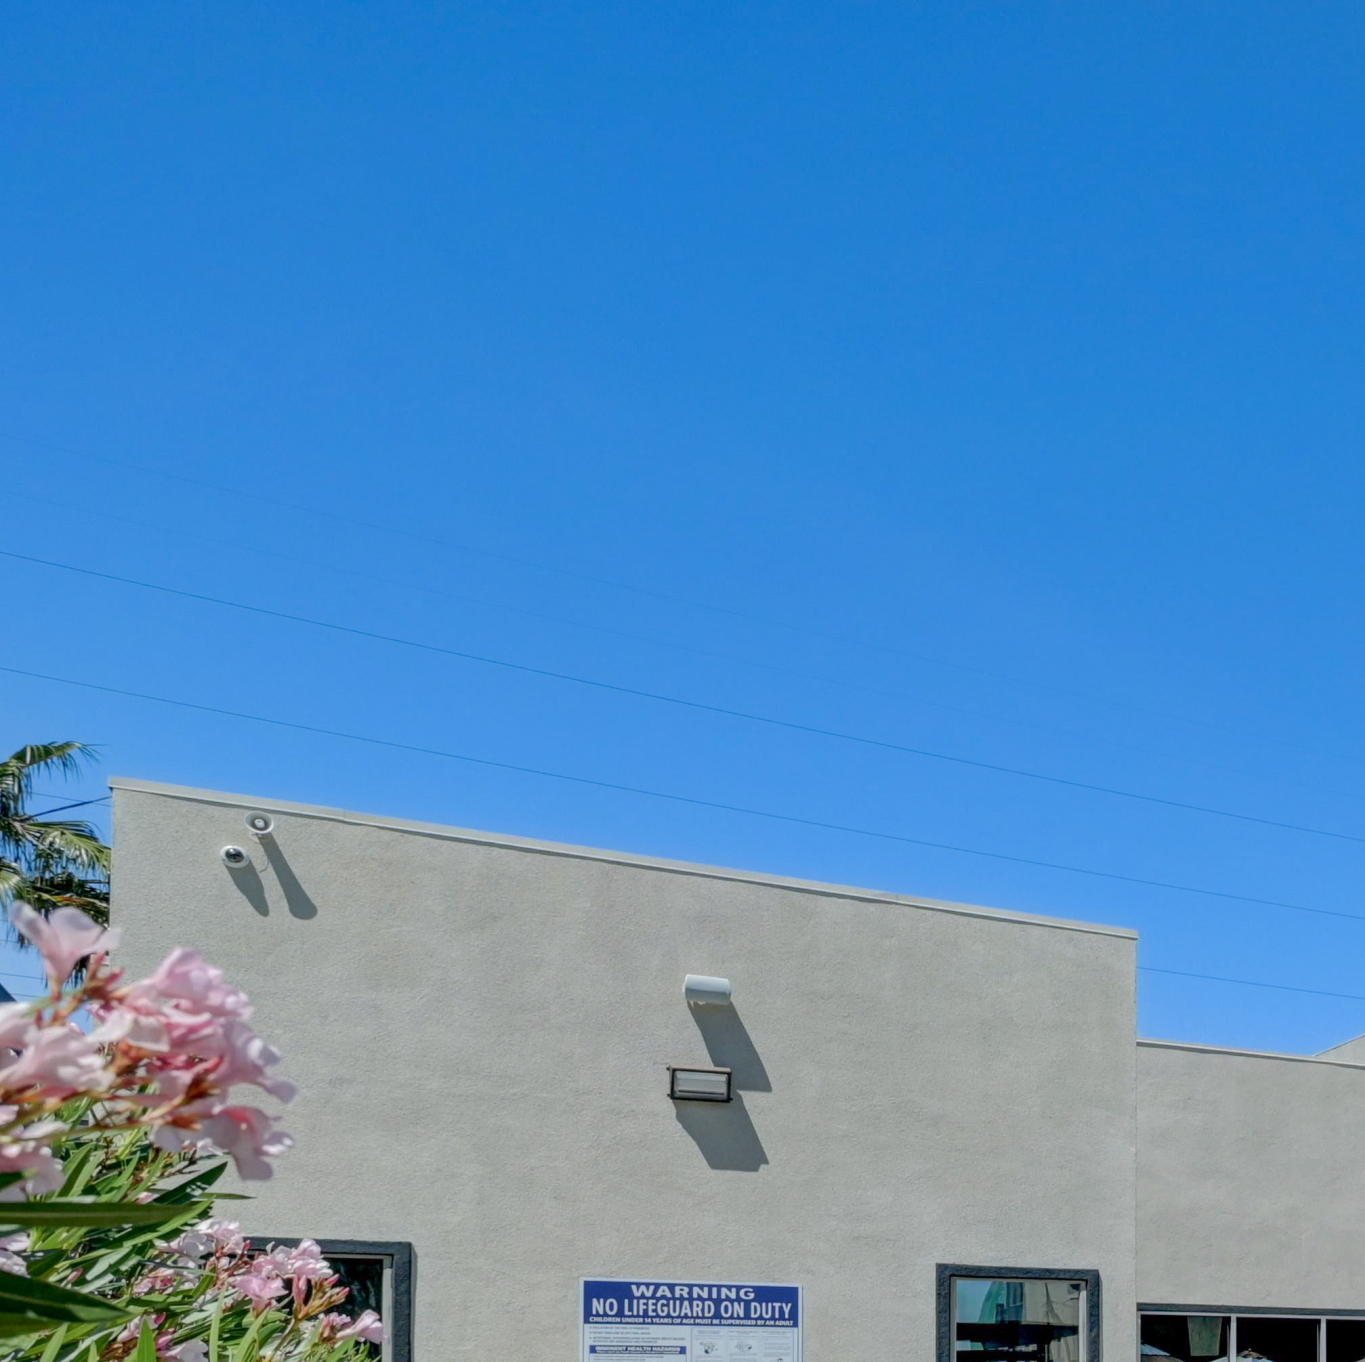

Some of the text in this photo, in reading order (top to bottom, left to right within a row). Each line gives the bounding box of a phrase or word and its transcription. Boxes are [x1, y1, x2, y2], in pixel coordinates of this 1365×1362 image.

[631, 1285, 755, 1300] WARNING
[592, 1298, 792, 1319] NO LIFEGUARD ON DUTY
